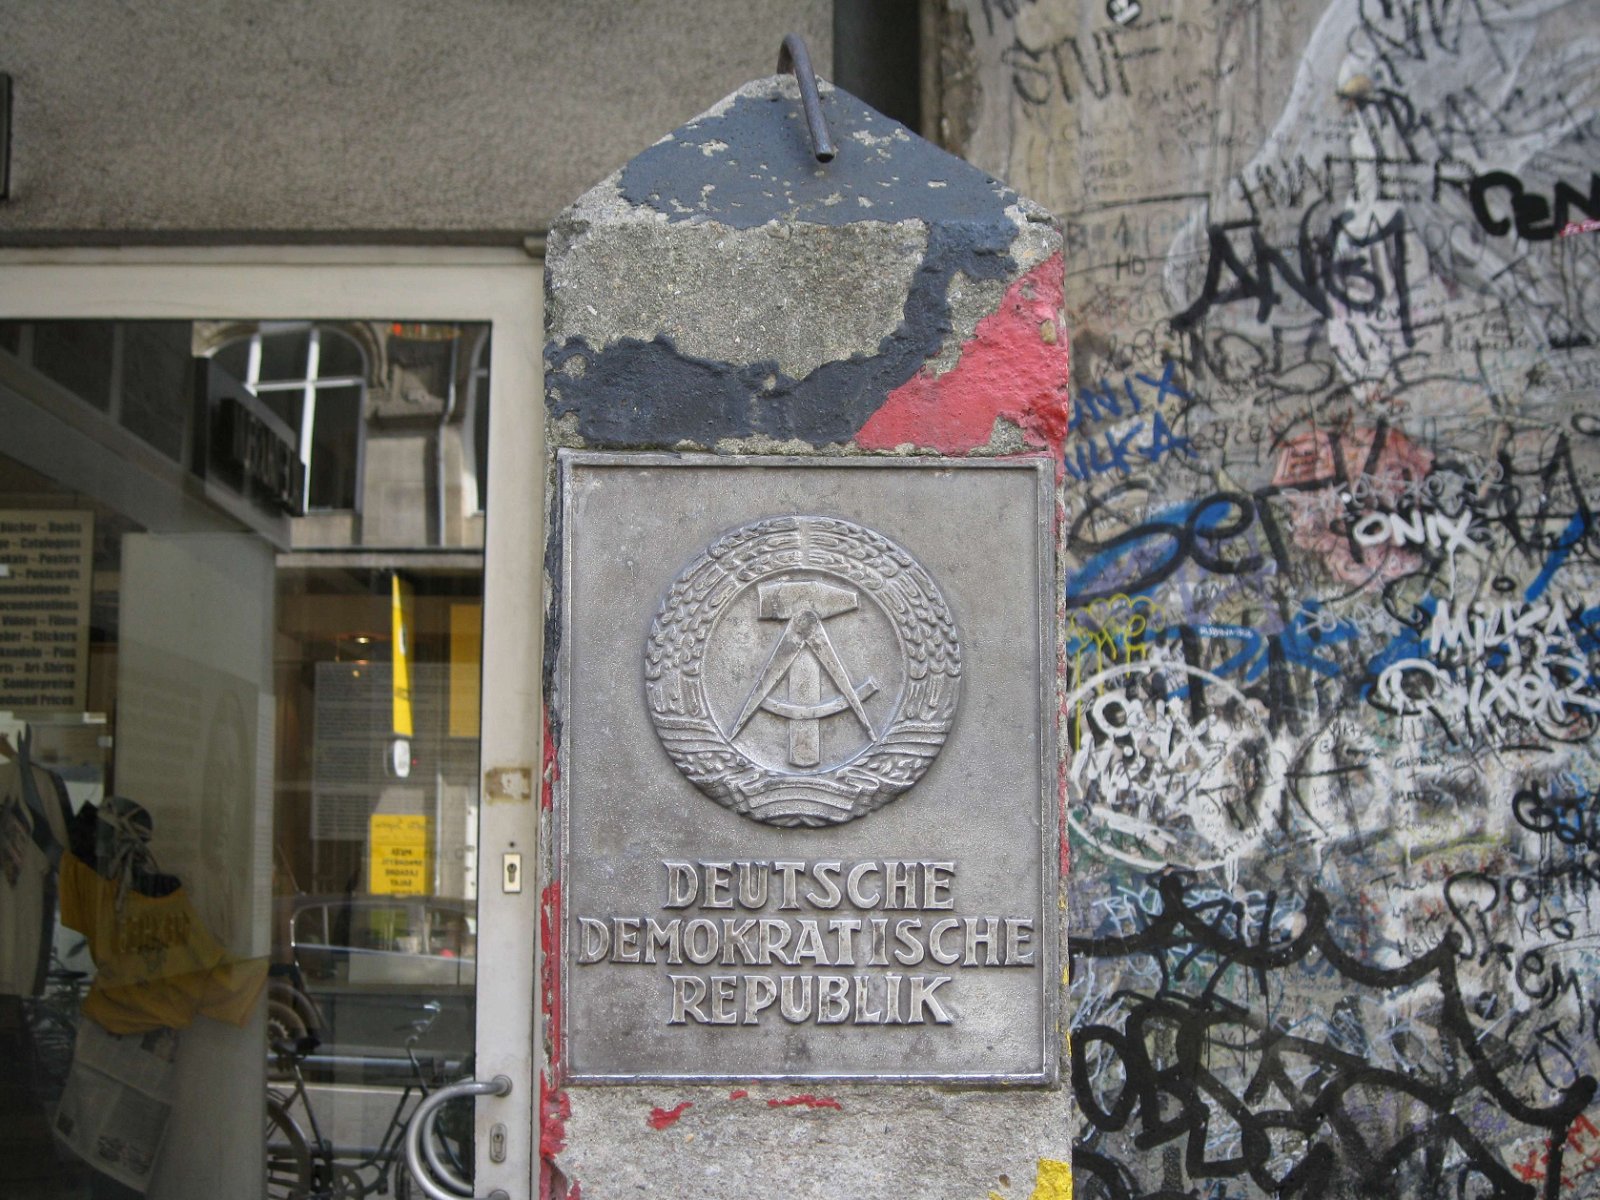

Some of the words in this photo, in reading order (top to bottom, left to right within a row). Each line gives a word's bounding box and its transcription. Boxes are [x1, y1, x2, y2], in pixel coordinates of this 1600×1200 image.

[662, 860, 956, 911] DEUTSCHE
[577, 916, 1036, 968] DEMOKRATISCHE
[667, 973, 954, 1027] REPUBLIK
